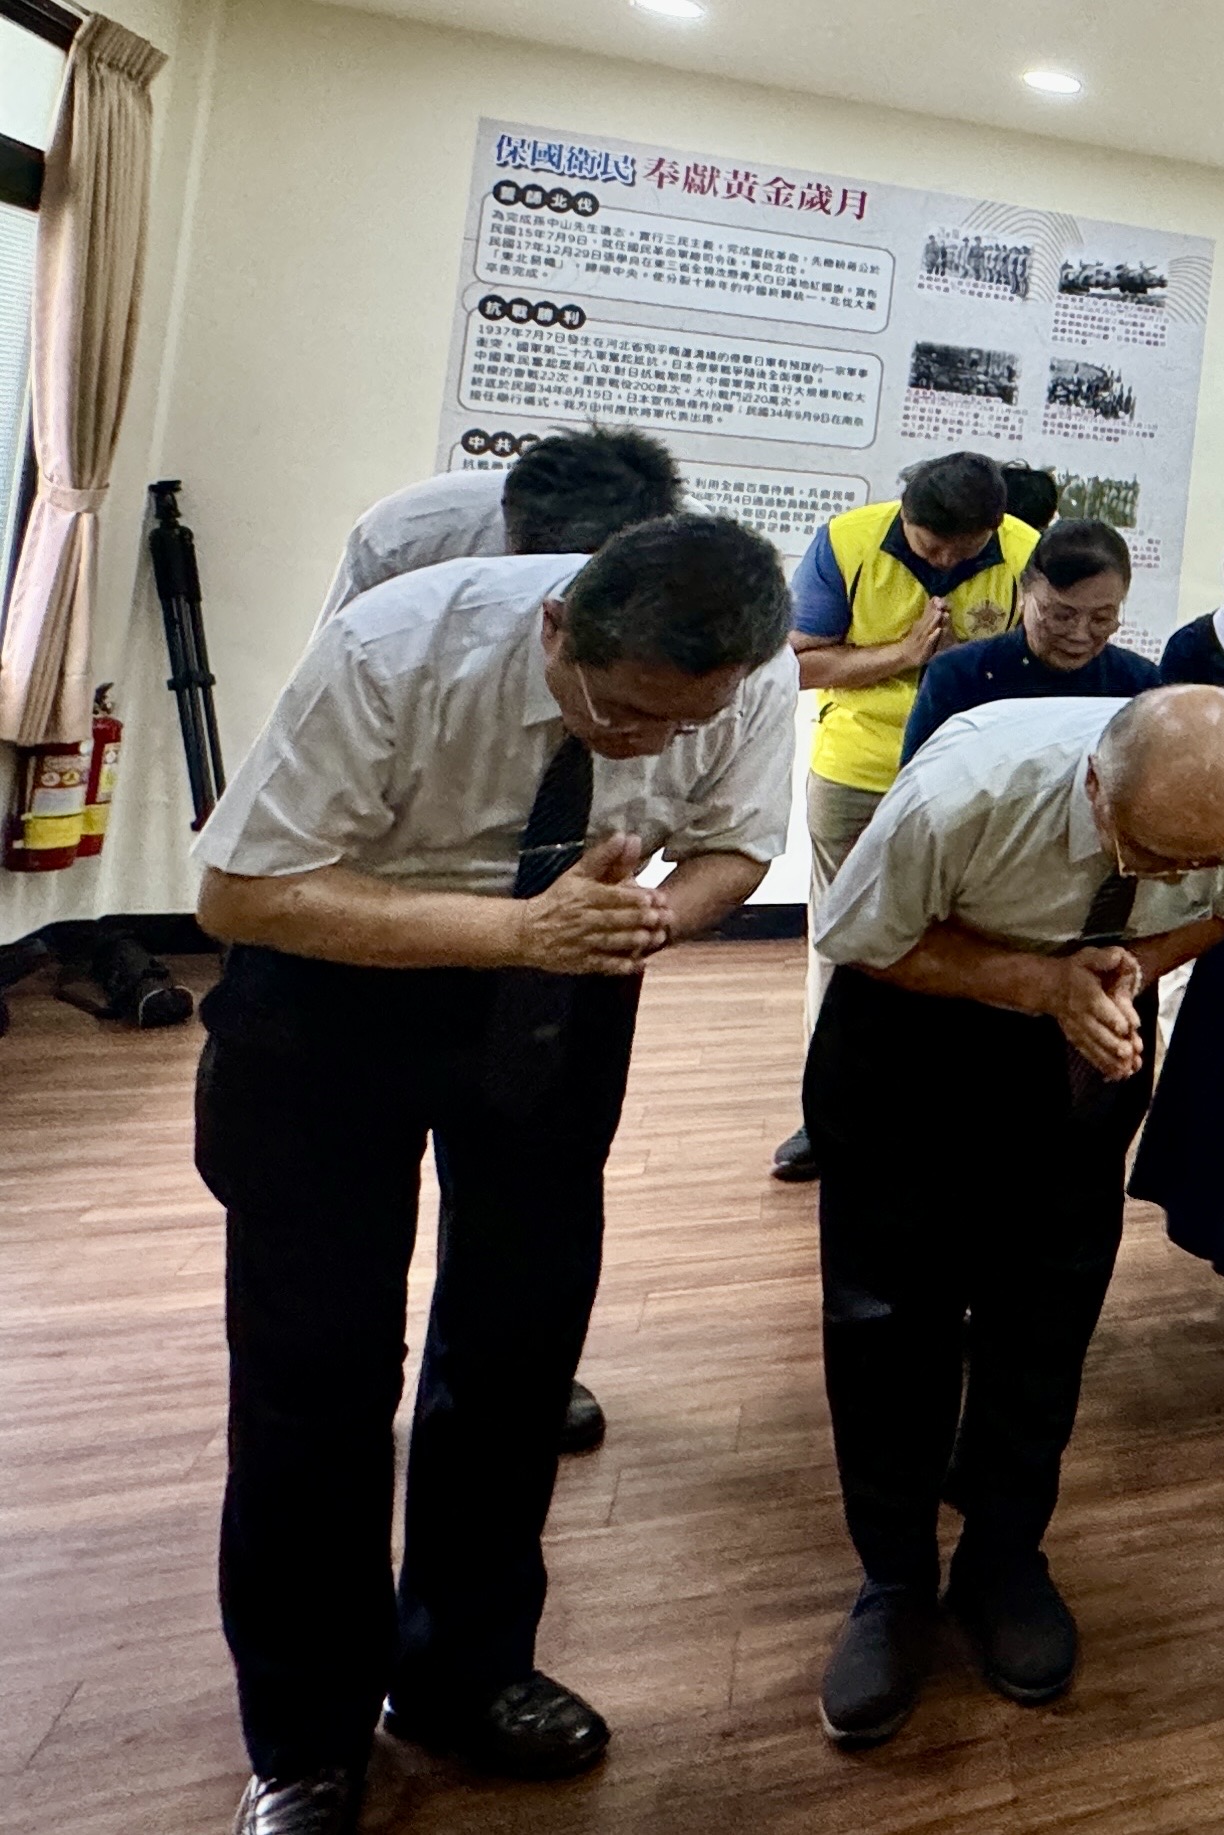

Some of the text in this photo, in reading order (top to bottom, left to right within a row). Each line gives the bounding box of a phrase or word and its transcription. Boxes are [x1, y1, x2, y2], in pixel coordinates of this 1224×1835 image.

[495, 133, 870, 220] 保國衛民 奉獻黃金歲月
